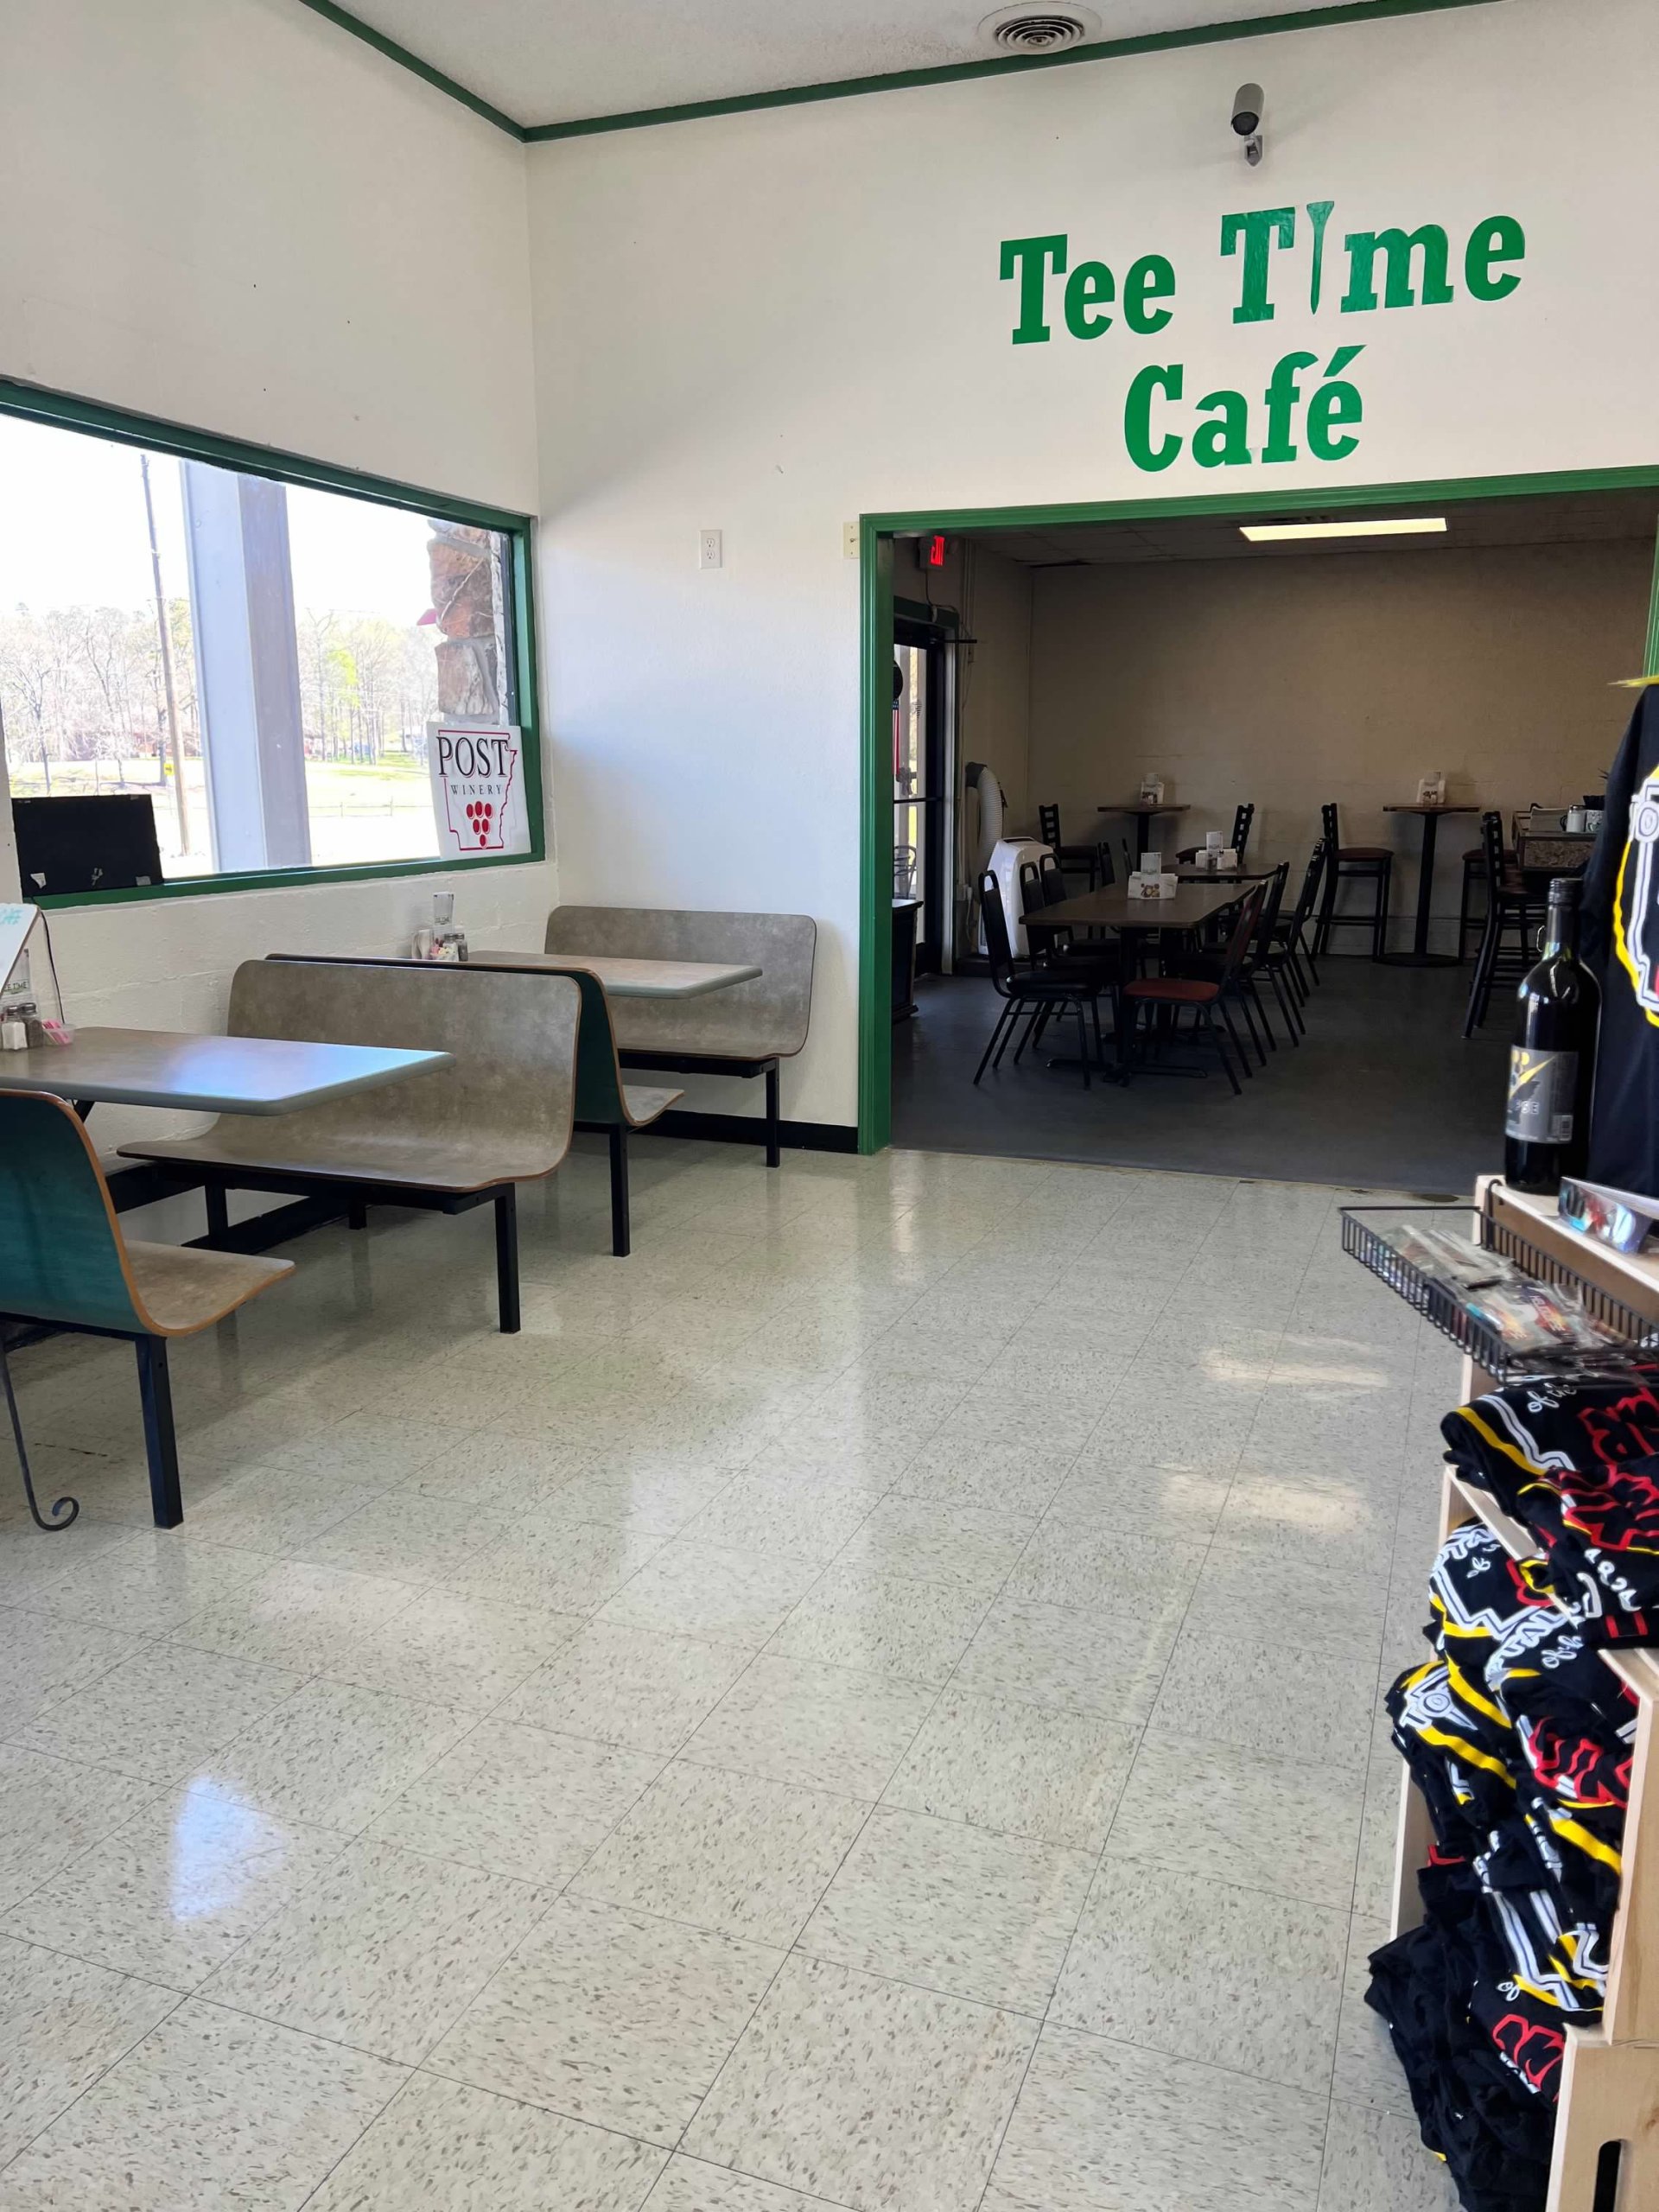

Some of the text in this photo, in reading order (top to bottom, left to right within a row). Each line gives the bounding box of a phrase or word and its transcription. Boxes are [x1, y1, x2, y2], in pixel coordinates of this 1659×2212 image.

[1000, 233, 1176, 345] Tee
[1123, 344, 1366, 473] Café
[435, 735, 509, 778] POST
[450, 784, 503, 795] WINERY
